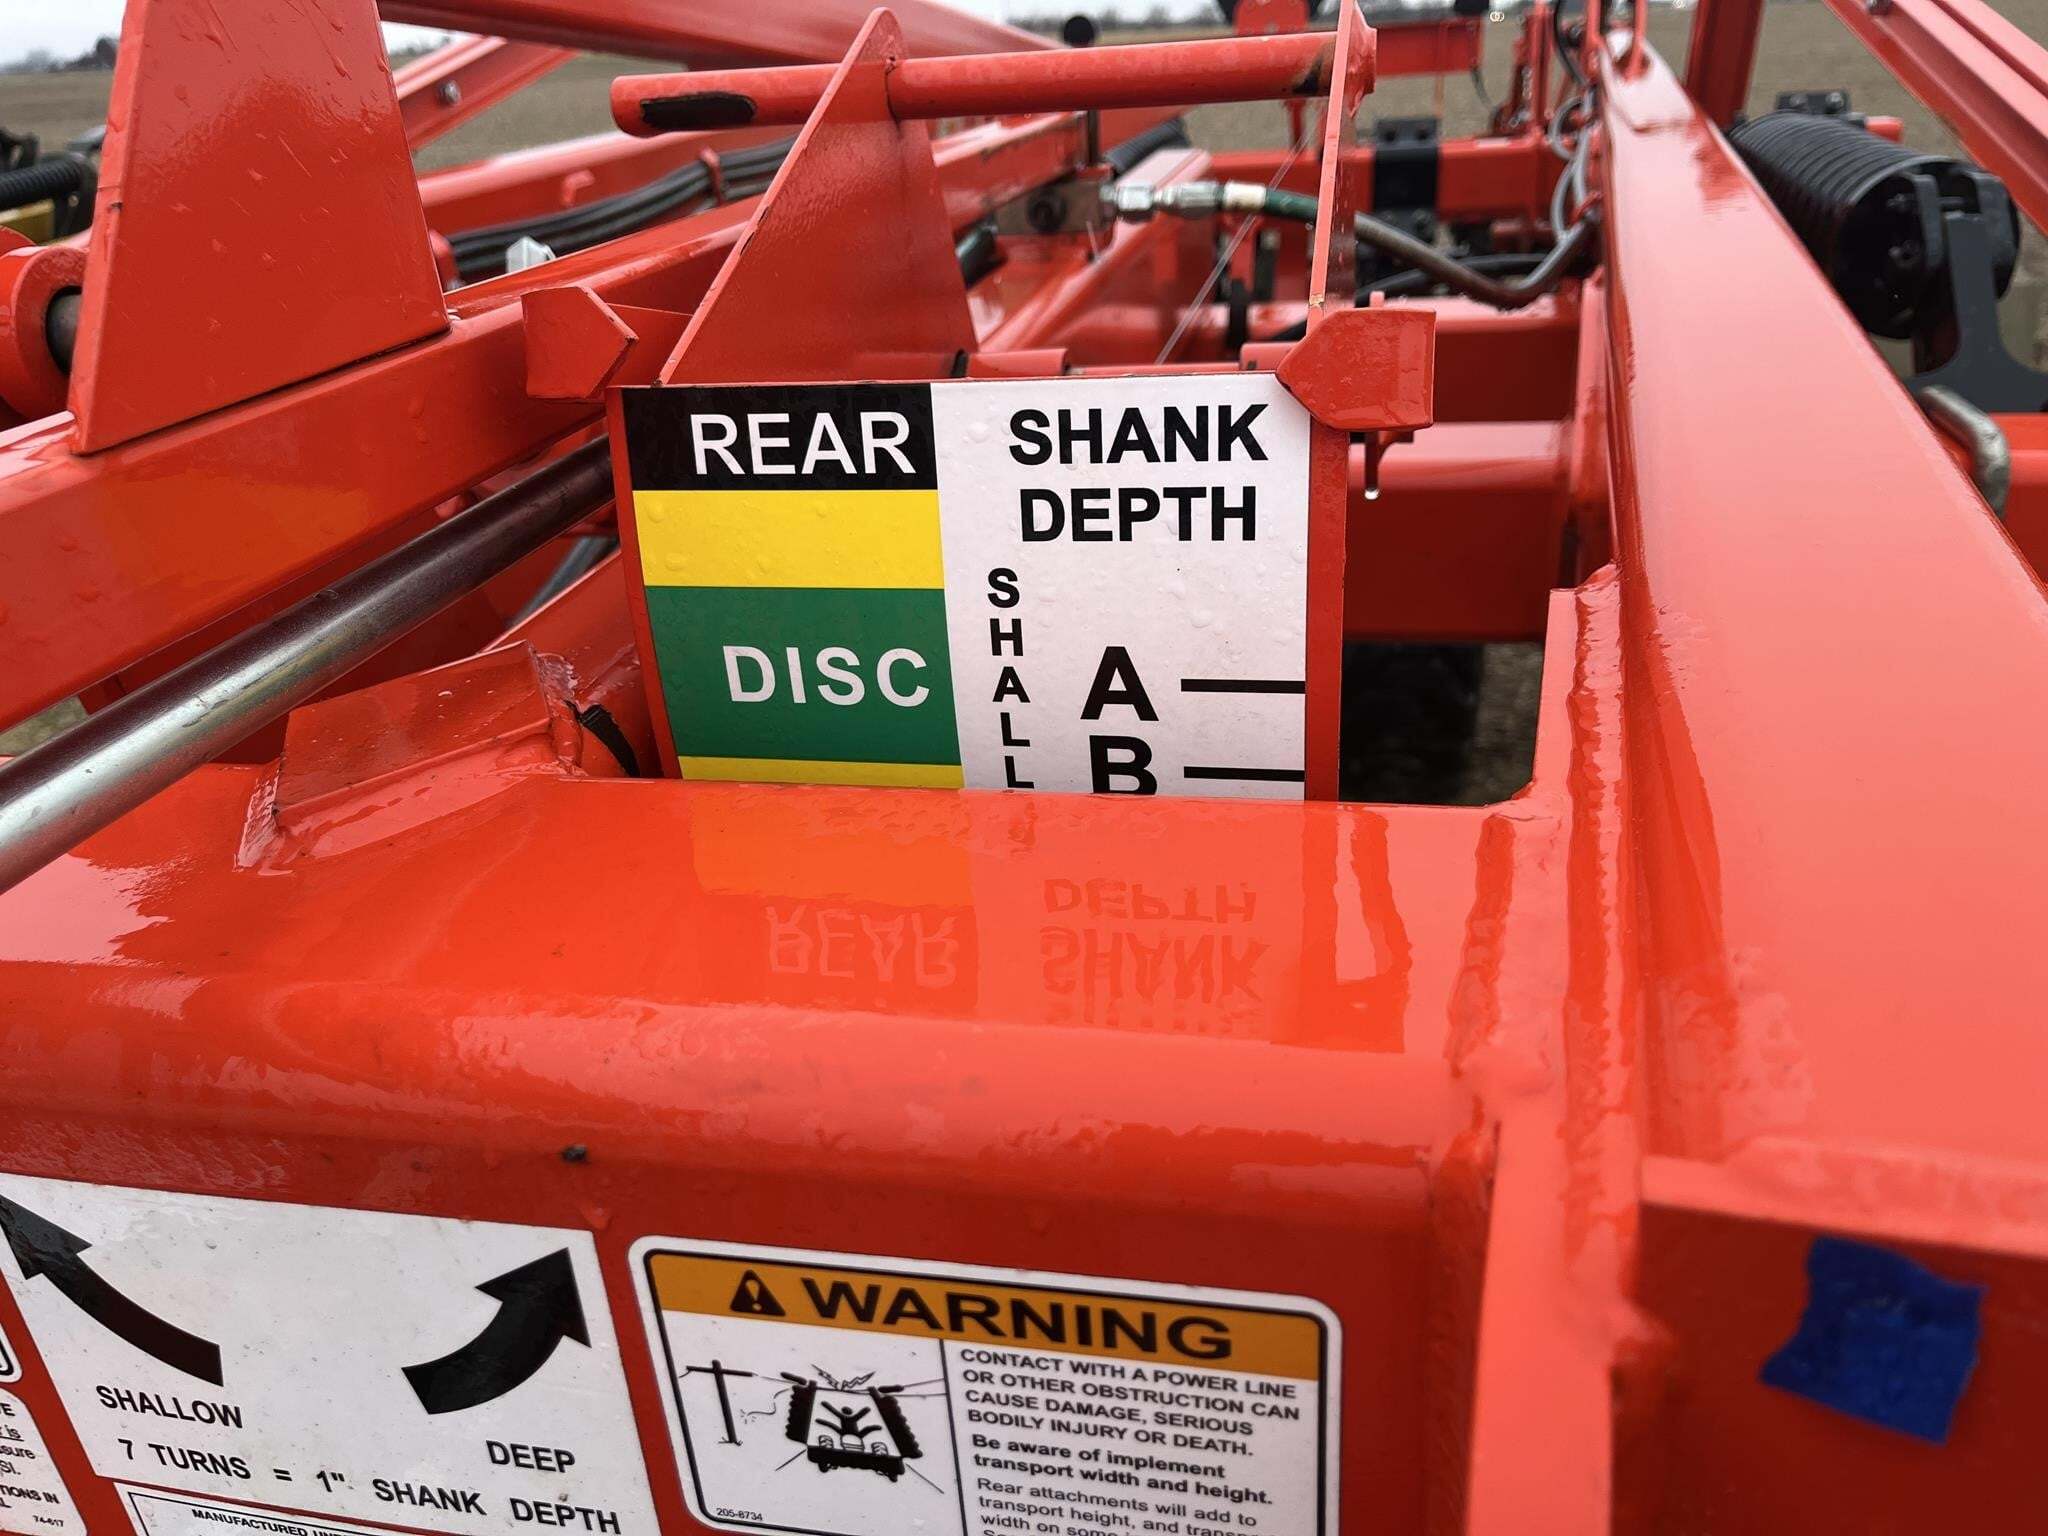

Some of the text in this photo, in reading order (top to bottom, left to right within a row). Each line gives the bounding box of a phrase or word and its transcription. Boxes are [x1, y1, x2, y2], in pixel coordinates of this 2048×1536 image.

[690, 411, 916, 476] REAR
[1008, 403, 1269, 465] SHANK
[1020, 486, 1257, 542] DEPTH
[722, 645, 931, 708] DISC
[986, 567, 1035, 789] SHALL
[1080, 645, 1160, 722] A
[1089, 734, 1158, 796] B
[801, 1276, 1232, 1360] WARNING
[960, 1348, 1297, 1399] CONTACT WITH A POWER LINE
[963, 1369, 1300, 1420] OR OTHER OBSTRUCTION CAN
[4, 1424, 21, 1439] is
[96, 1385, 243, 1429] SHALLOW
[965, 1389, 1254, 1435] CAUSE DAMAGE, SERIOUS
[968, 1409, 1254, 1456] BODILY INJURY OR DEATH.
[486, 1439, 576, 1473] DEEP
[972, 1433, 1226, 1478] Be aware of implement
[974, 1453, 1273, 1505] transport width and height.
[117, 1438, 134, 1461] 7
[148, 1442, 251, 1480] TURNS
[372, 1478, 488, 1516] SHANK
[509, 1497, 622, 1535] DEPTH
[977, 1477, 1257, 1528] Rear attachments will add to
[191, 1508, 309, 1536] MANUFACTURED
[716, 1507, 764, 1521] 205-8734
[979, 1496, 1064, 1517] transport
[1143, 1520, 1179, 1534] and
[981, 1514, 1031, 1530] width
[1037, 1522, 1060, 1534] on
